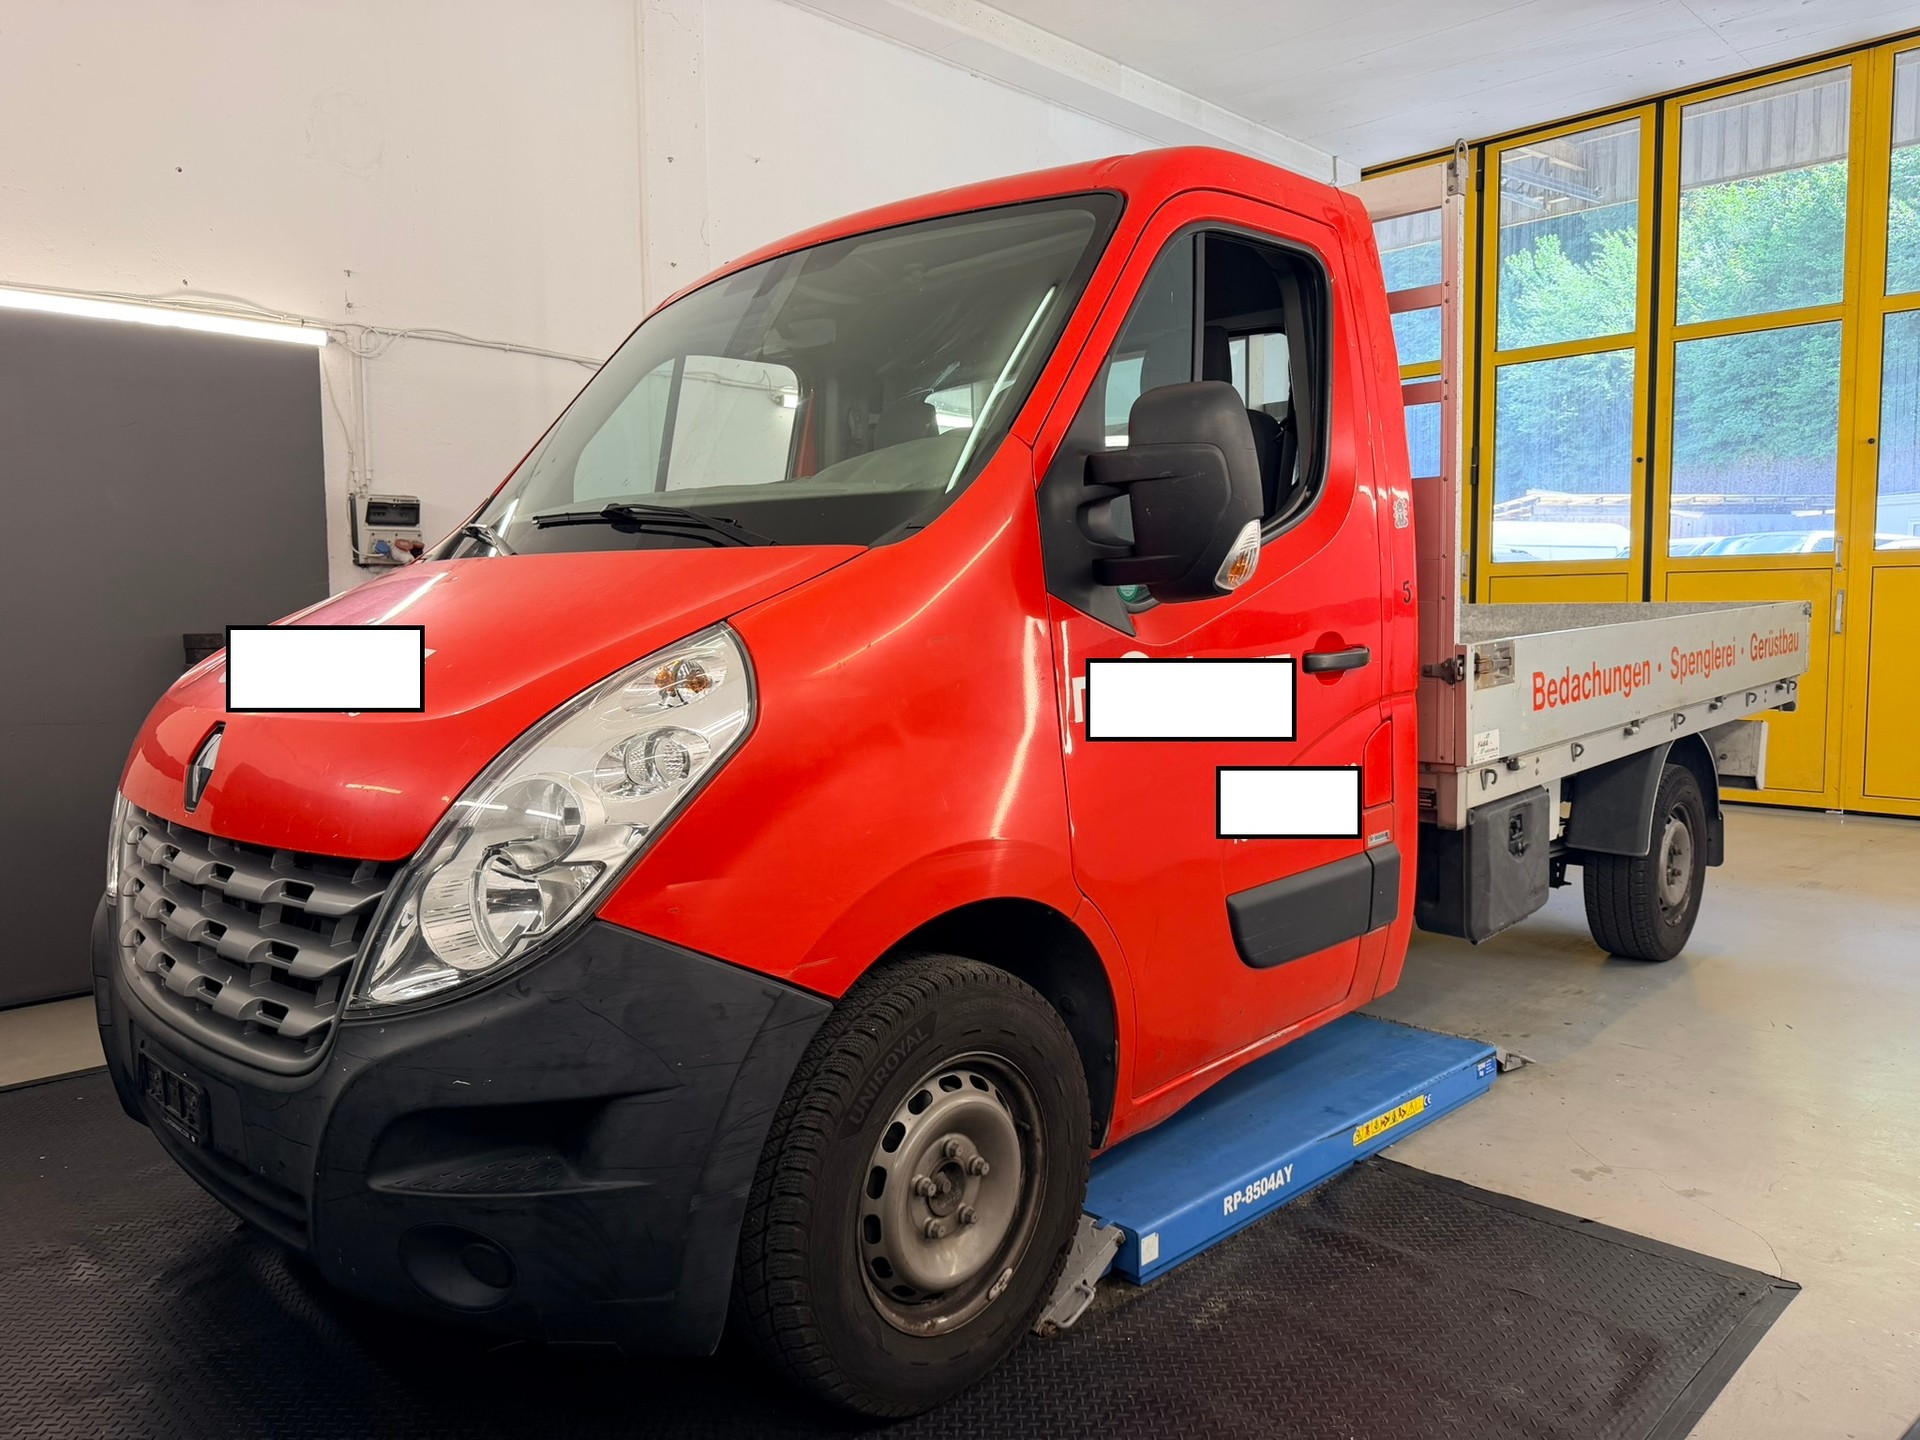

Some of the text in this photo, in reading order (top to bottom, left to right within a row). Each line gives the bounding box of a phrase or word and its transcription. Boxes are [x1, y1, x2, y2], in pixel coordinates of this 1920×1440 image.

[1403, 580, 1412, 604] 5
[1532, 658, 1650, 711] Bedachungen
[1670, 638, 1736, 685] Spenglerei
[1750, 630, 1799, 662] Gerüstbau
[850, 1028, 928, 1124] UNIROYAL
[1223, 1164, 1293, 1215] RP-8504AY
